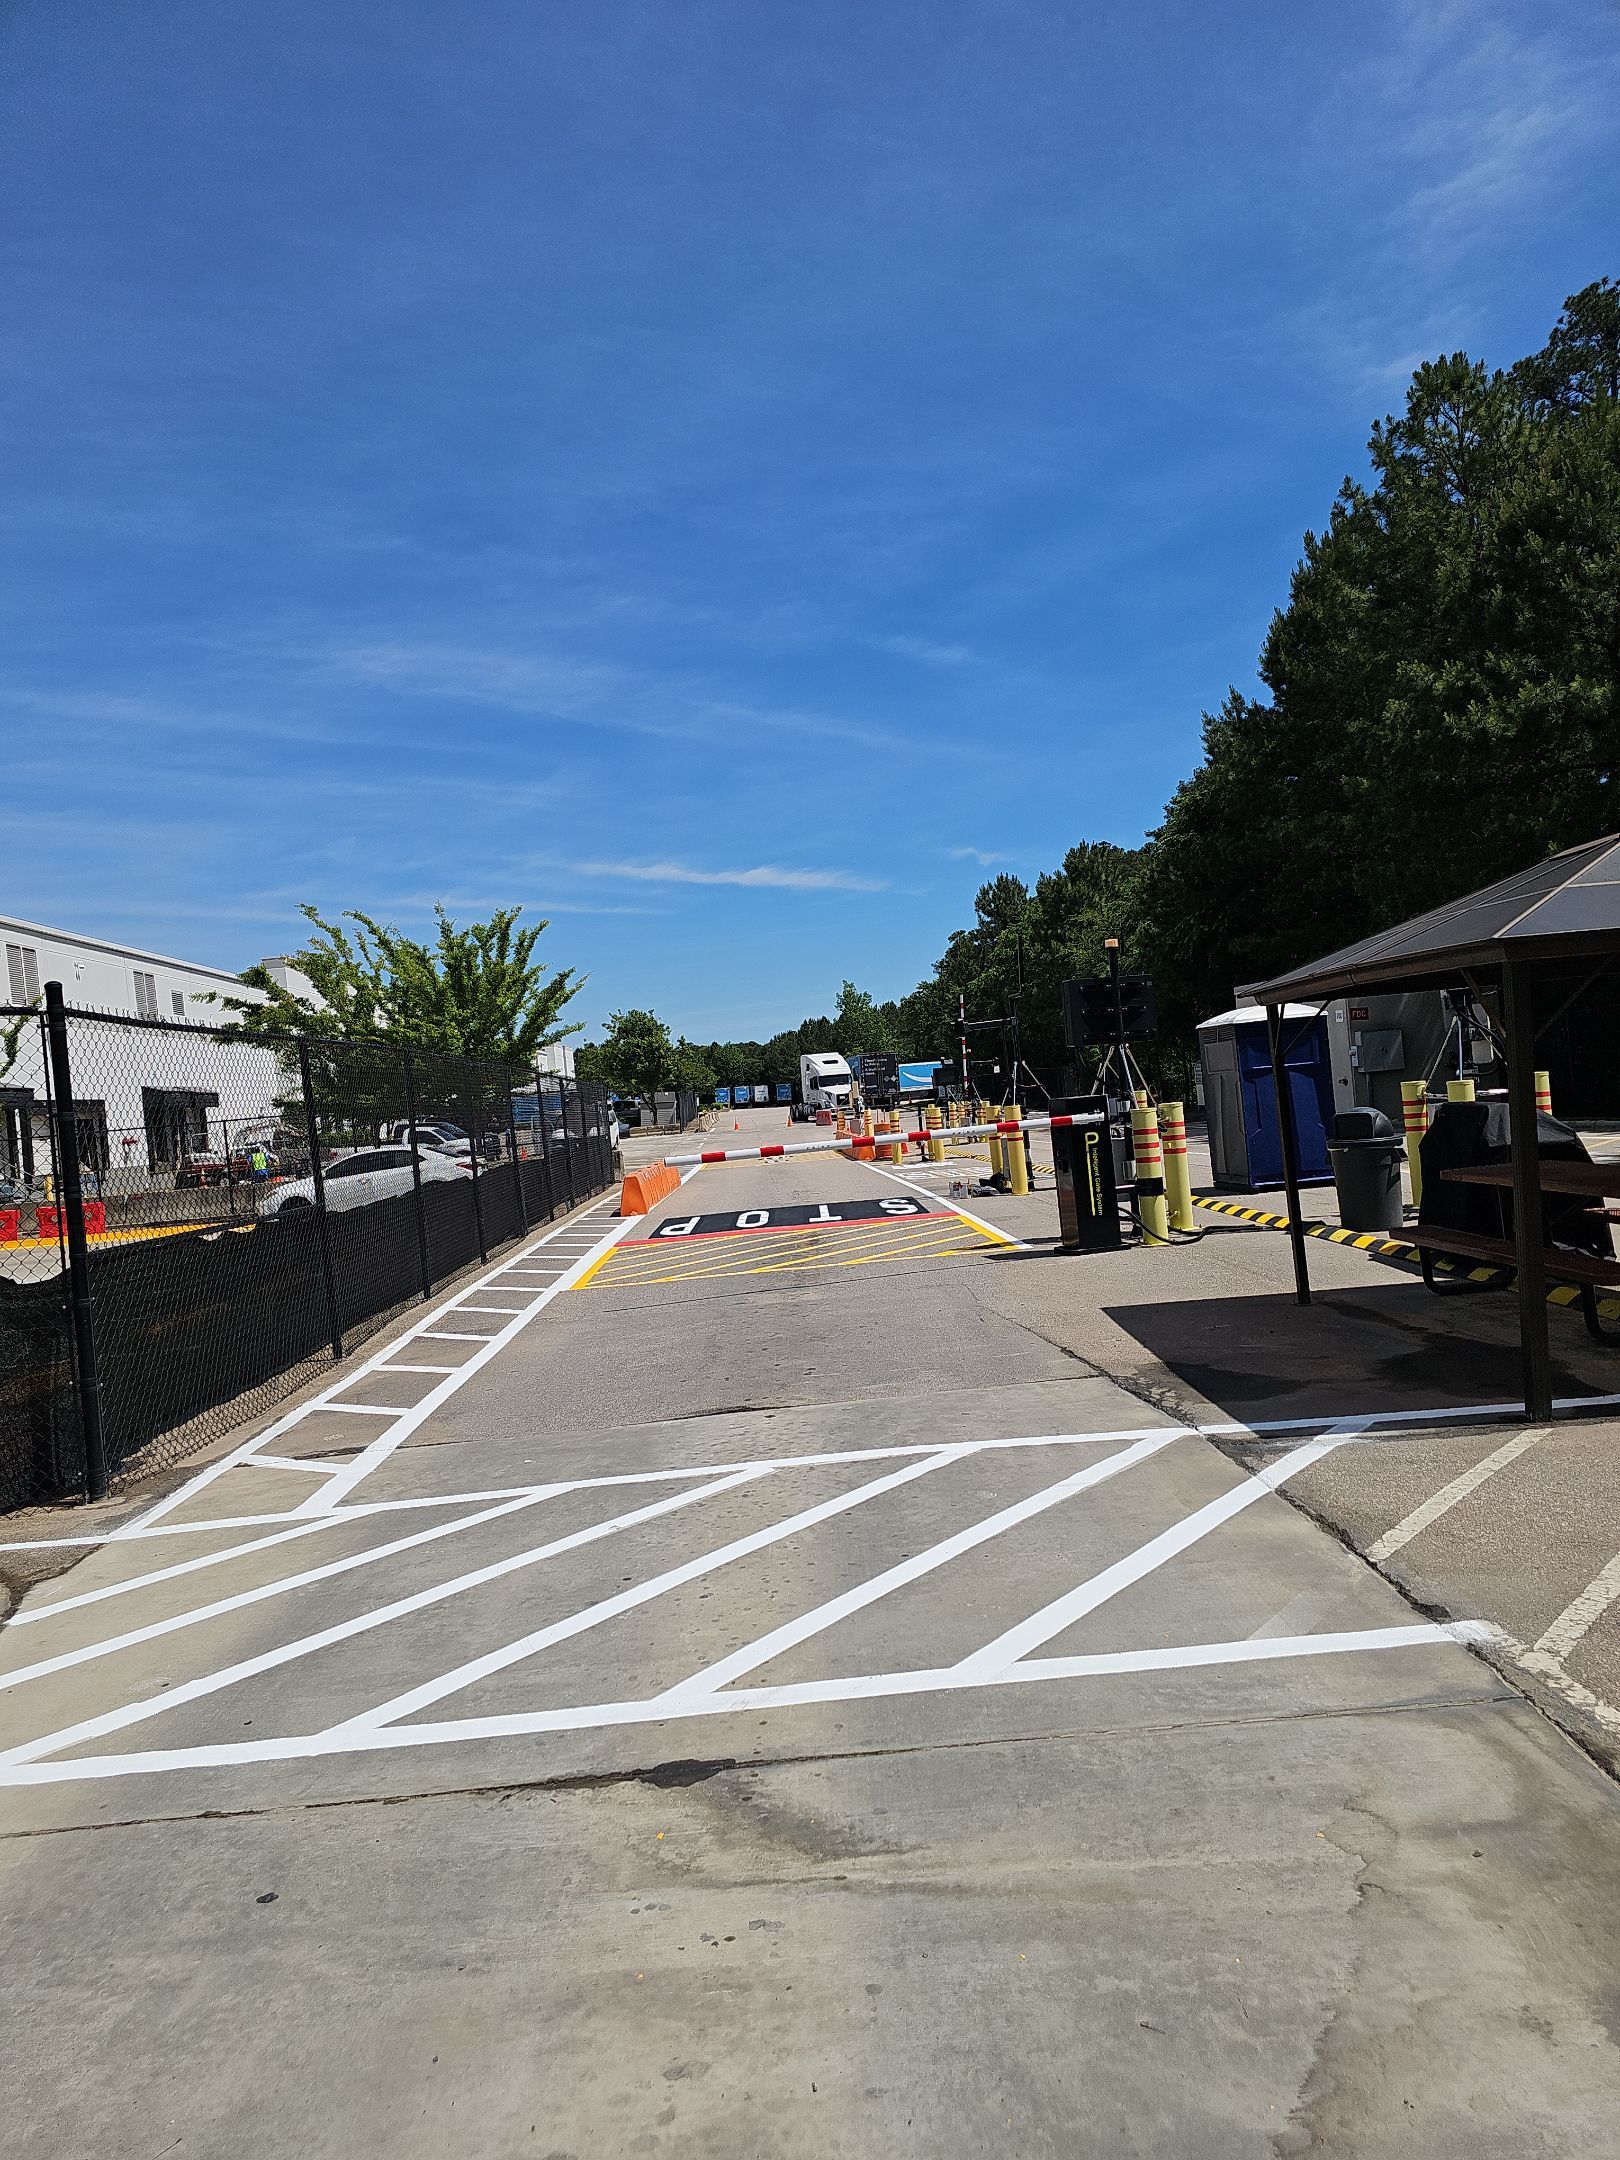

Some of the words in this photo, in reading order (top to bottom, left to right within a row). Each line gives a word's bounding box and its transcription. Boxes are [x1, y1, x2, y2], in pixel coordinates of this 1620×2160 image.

[1352, 1010, 1367, 1019] FDC
[1092, 1147, 1100, 1177] Intelligent
[1094, 1177, 1102, 1192] Gate
[660, 1199, 918, 1236] STOP
